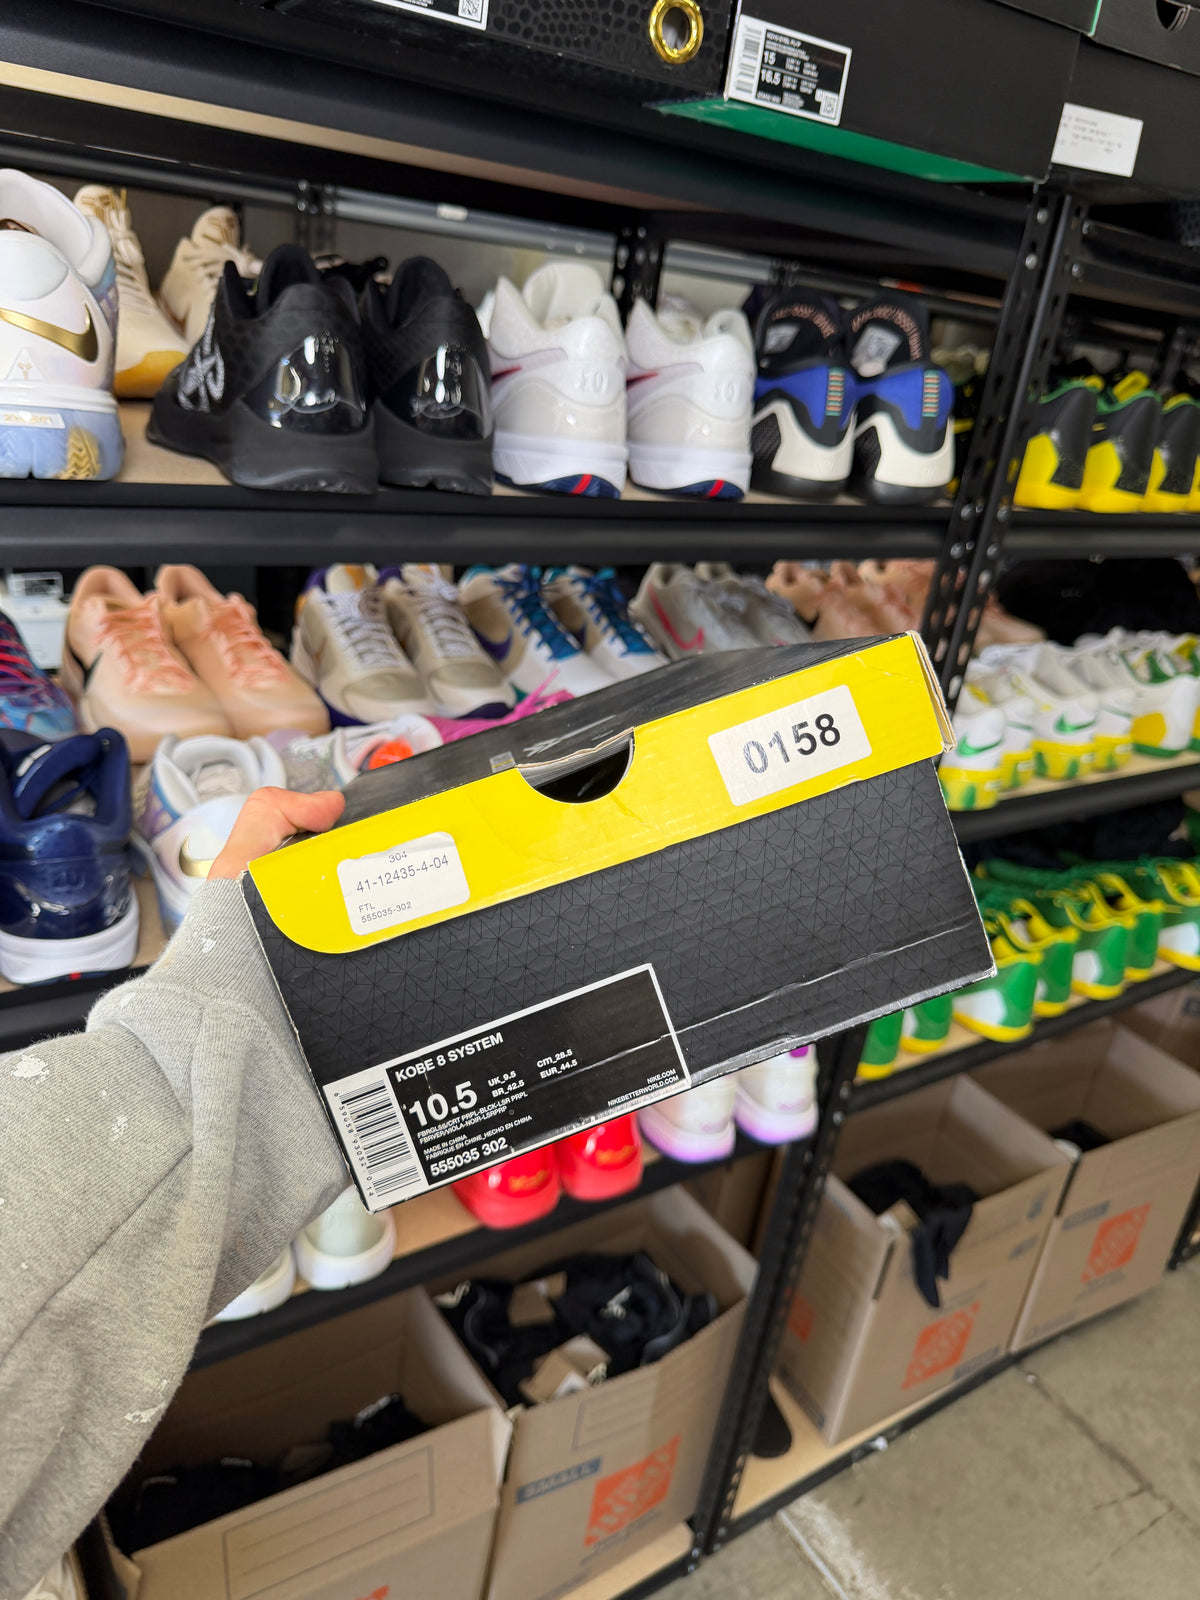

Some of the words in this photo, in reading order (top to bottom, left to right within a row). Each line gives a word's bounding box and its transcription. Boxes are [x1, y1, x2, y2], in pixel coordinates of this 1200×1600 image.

[743, 713, 841, 774] 0158
[388, 850, 408, 863] 304
[356, 854, 449, 893] 41-12435-4-04
[358, 902, 376, 913] FTL
[361, 901, 412, 923] 555035-302
[395, 1058, 436, 1082] KOBE
[436, 1054, 447, 1066] 8
[447, 1032, 504, 1062] SYSTEM
[536, 1048, 573, 1068] cm_28.5
[488, 1070, 517, 1087] UK_9.5
[540, 1058, 578, 1079] EUR_44.5
[646, 1068, 677, 1085] NIKE.COM
[491, 1079, 525, 1098] BR_42.5
[510, 1091, 528, 1102] PRPL
[607, 1074, 679, 1107] NIKEBETTERWORLD.COM
[408, 1080, 478, 1127] 10.5
[423, 1143, 442, 1156] MADE
[449, 1133, 468, 1146] CHINA
[425, 1146, 456, 1161] FABRIQUE
[455, 1142, 464, 1150] EN
[504, 1122, 514, 1131] EN
[513, 1115, 532, 1127] CHINA
[430, 1147, 480, 1177] 555035
[481, 1136, 508, 1156] 302
